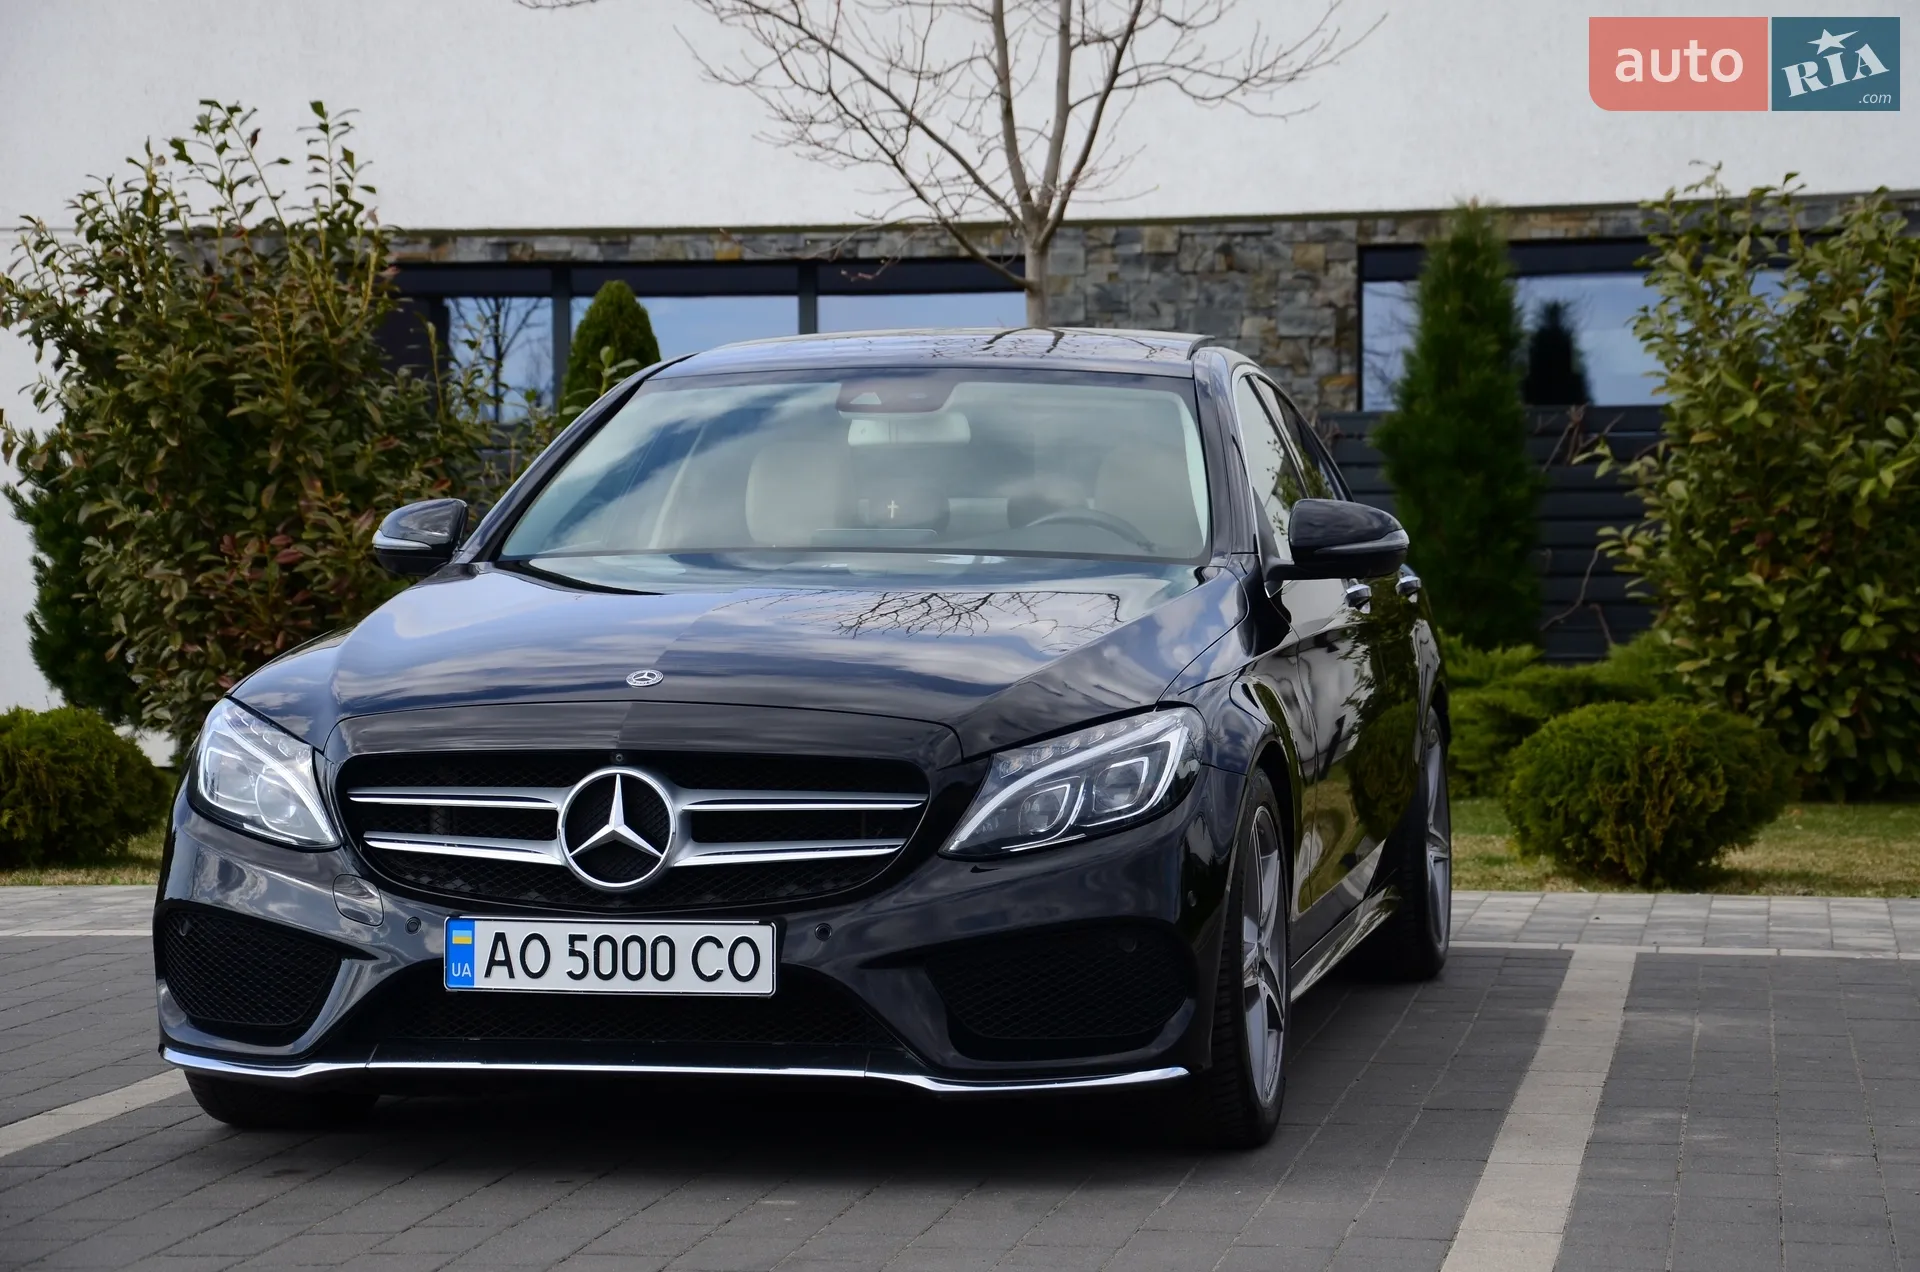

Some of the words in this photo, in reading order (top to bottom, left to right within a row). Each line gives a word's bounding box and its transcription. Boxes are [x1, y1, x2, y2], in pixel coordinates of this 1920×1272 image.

[451, 962, 472, 978] UA
[484, 931, 551, 979] AO
[565, 933, 676, 982] 5000
[691, 934, 761, 983] CO
